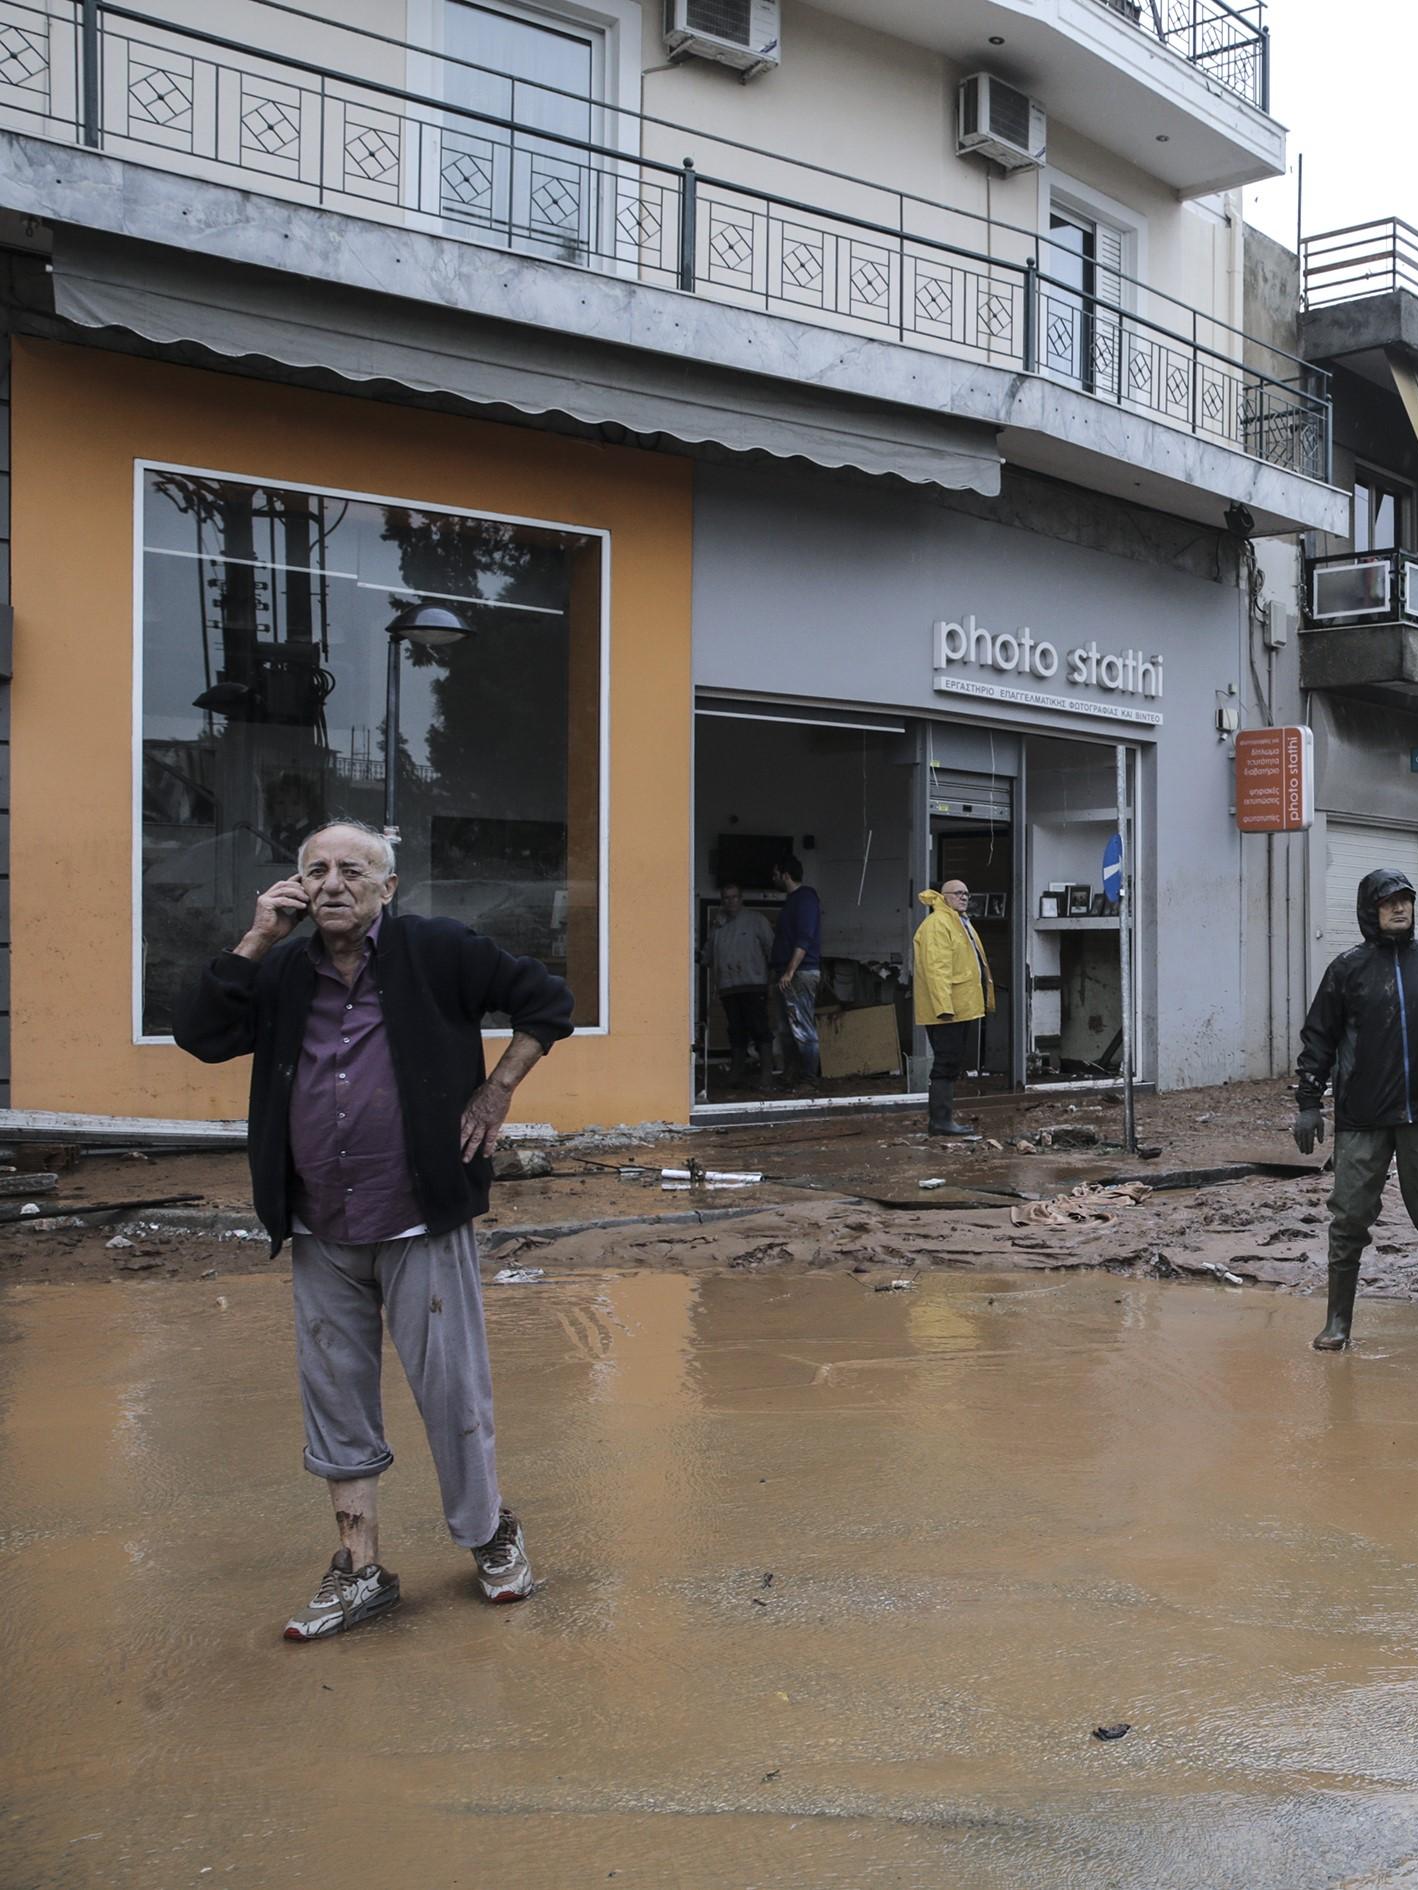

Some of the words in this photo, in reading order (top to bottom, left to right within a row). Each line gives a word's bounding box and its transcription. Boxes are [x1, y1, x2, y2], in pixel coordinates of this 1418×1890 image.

[934, 615, 1058, 678] photo
[1067, 641, 1163, 698] stathi
[945, 679, 995, 696] ΕΡΓΑΣΤΗΡΙΟ
[1000, 689, 1066, 708] ΕΠΑΓΓΕΛΜΑΤΙΚΗΣ
[1069, 702, 1119, 717] ΦΩΤΟΓΡΑΦΙΑΣ
[1121, 710, 1133, 720] ΚΑΙ
[1135, 712, 1160, 723] ΒΙΝΤΕΟ
[1288, 737, 1298, 774] stathi
[1288, 778, 1301, 821] photo
